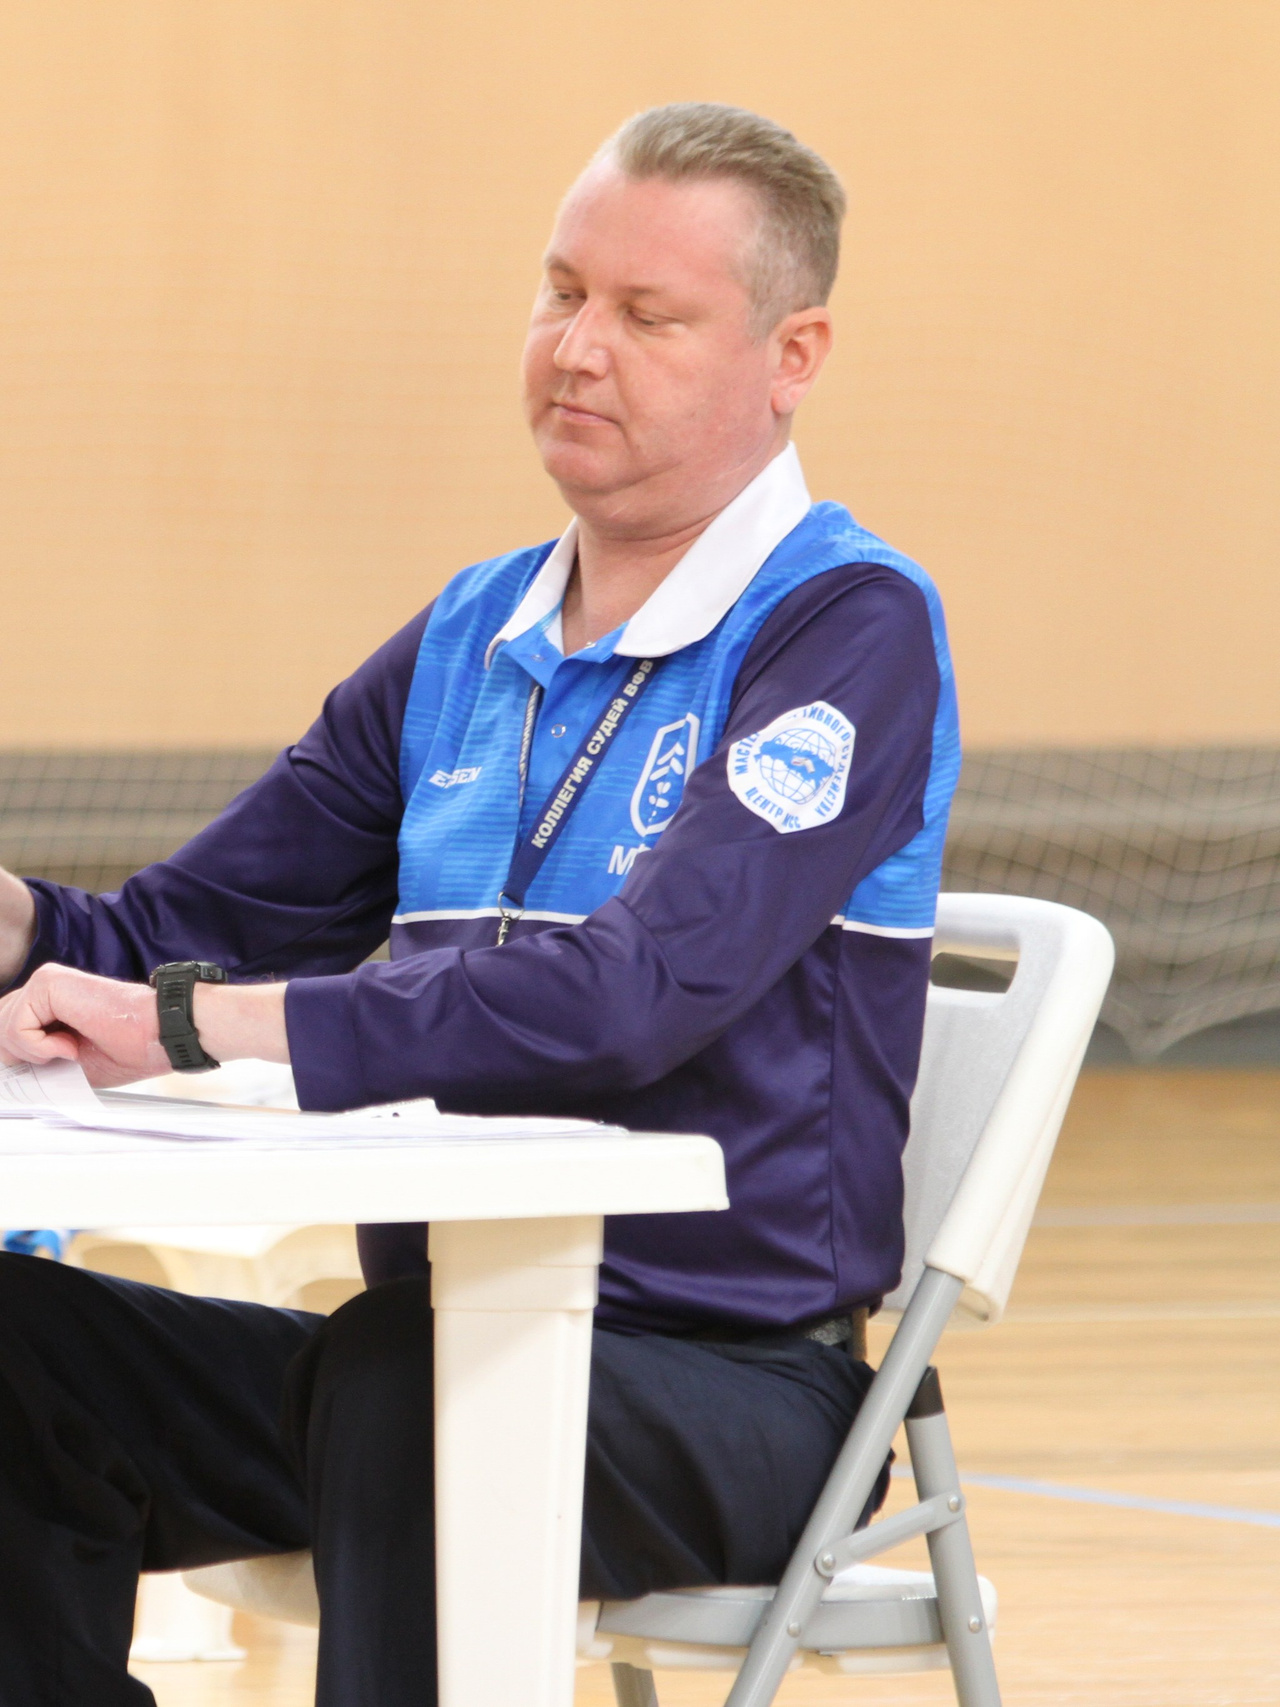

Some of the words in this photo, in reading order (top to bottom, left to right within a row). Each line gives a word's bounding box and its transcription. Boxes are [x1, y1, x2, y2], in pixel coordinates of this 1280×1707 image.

[531, 756, 593, 849] КОЛЛЕГИЯ
[587, 698, 629, 755] СУДЕЙ
[623, 659, 654, 697] ВФВ
[745, 787, 784, 818] ЦЕНТР
